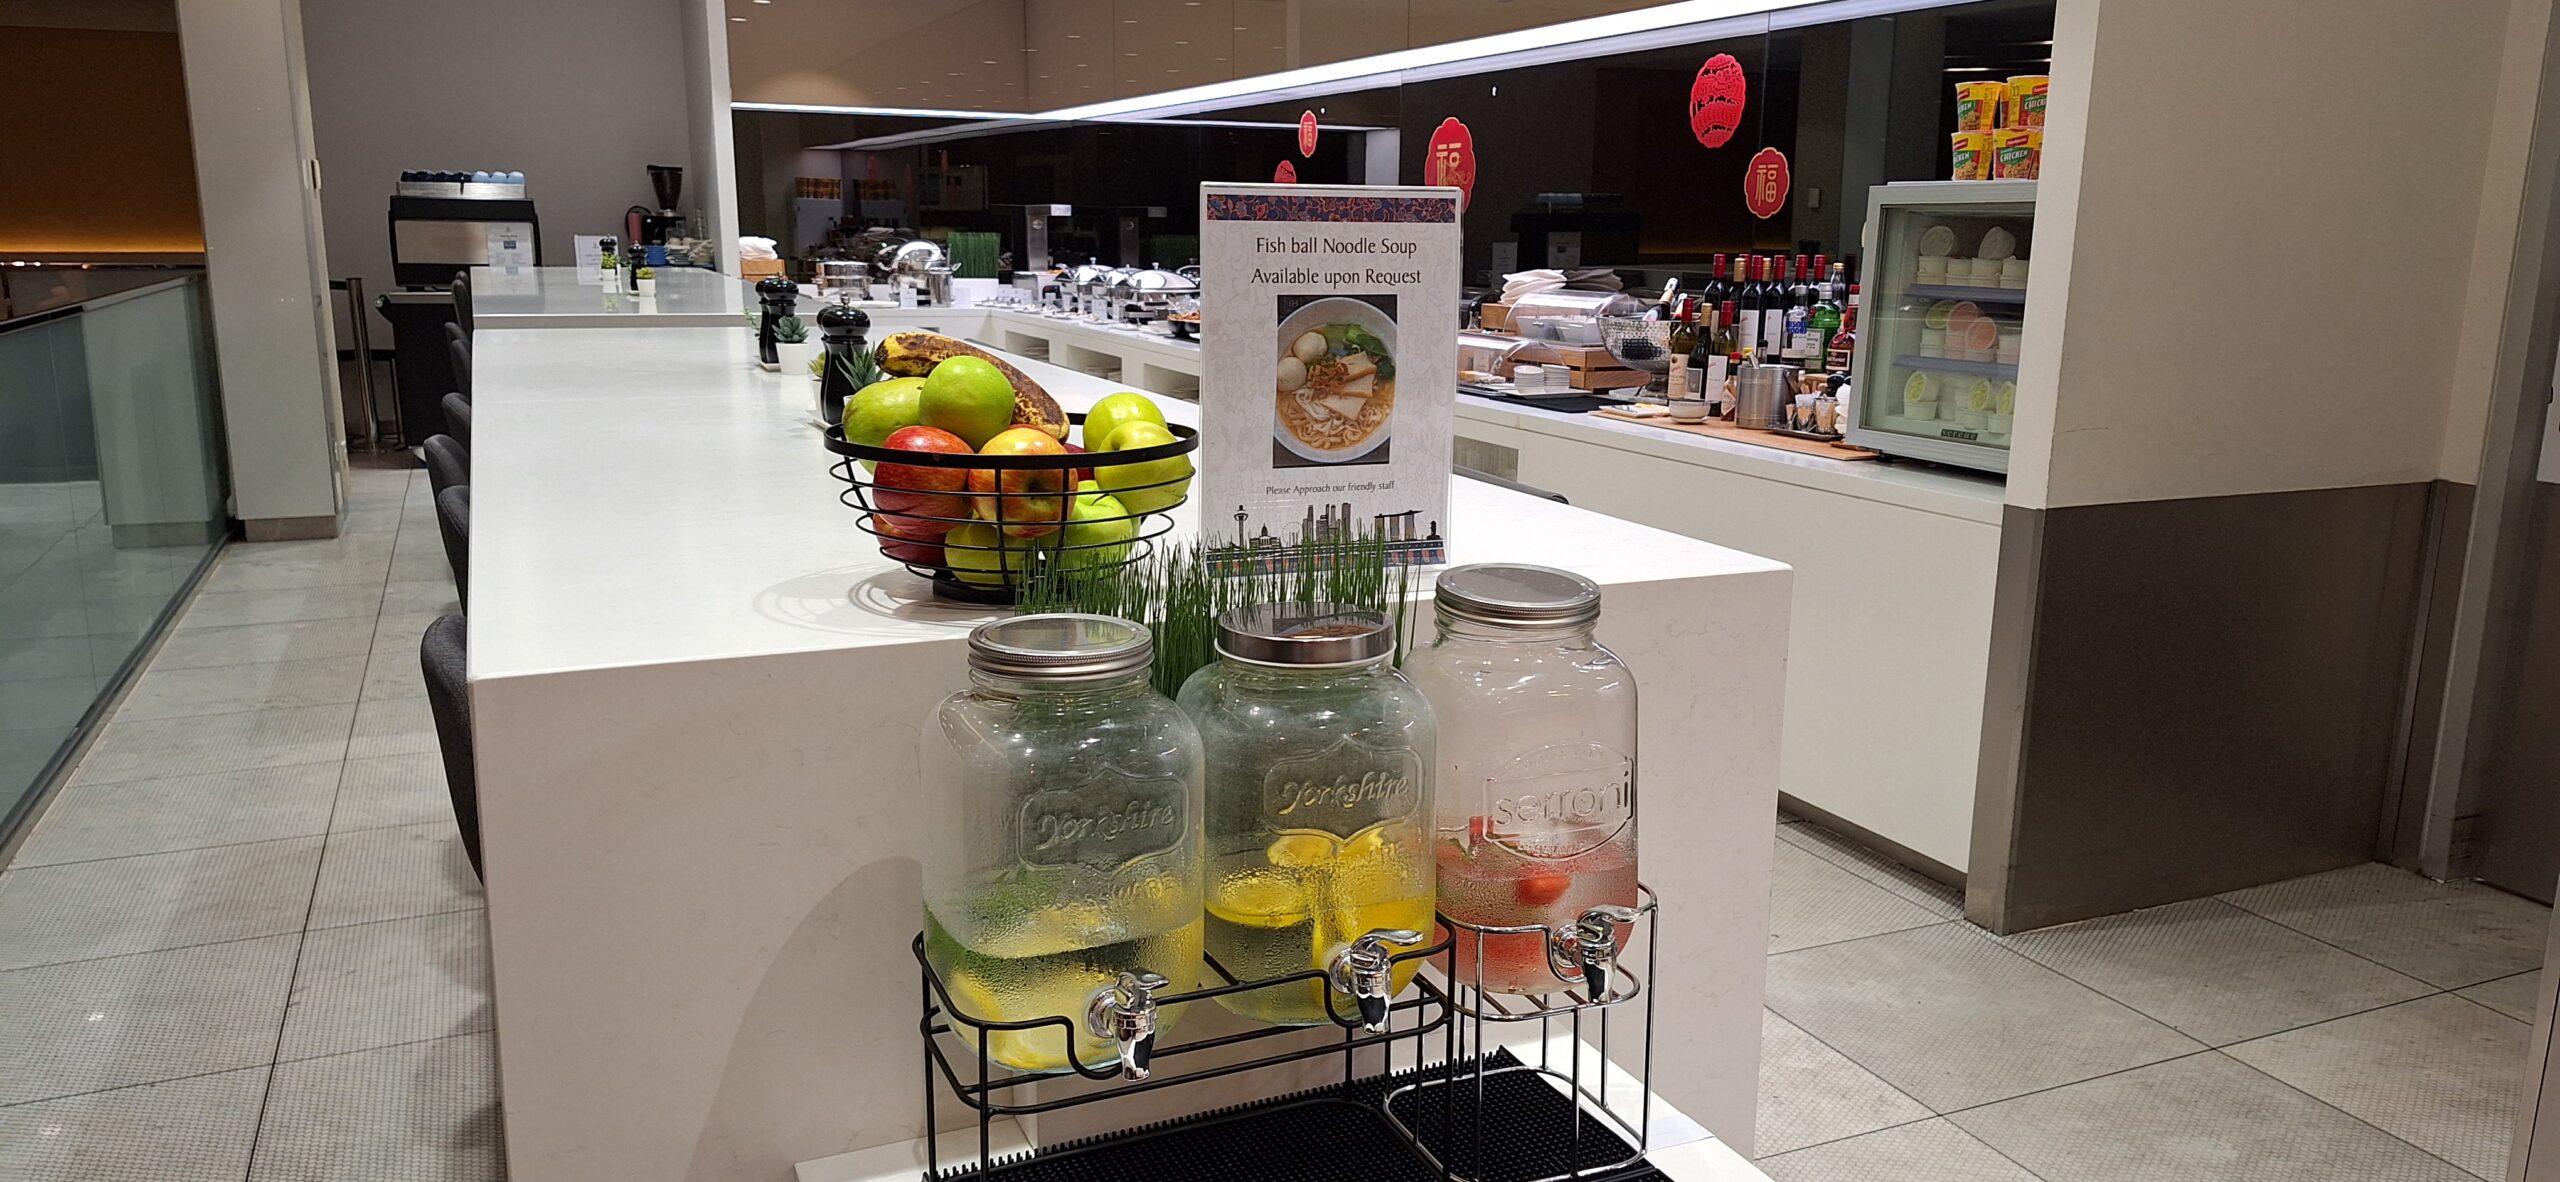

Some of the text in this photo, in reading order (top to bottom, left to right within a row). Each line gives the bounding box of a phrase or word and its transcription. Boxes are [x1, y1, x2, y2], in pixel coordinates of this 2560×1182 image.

[2000, 149, 2028, 163] CHICKEN
[1755, 164, 1778, 207] 福
[1256, 237, 1417, 259] Fish ball Noodle Soup
[1251, 267, 1422, 289] Available upon Request
[1942, 429, 1977, 440] serene
[1266, 486, 1291, 495] Please
[1293, 483, 1331, 496] Approach
[1347, 481, 1376, 494] friendly
[1378, 480, 1395, 490] staff
[1278, 771, 1410, 815] Yorkshire
[1494, 770, 1630, 825] serroni
[1035, 799, 1176, 851] Yorkshire
